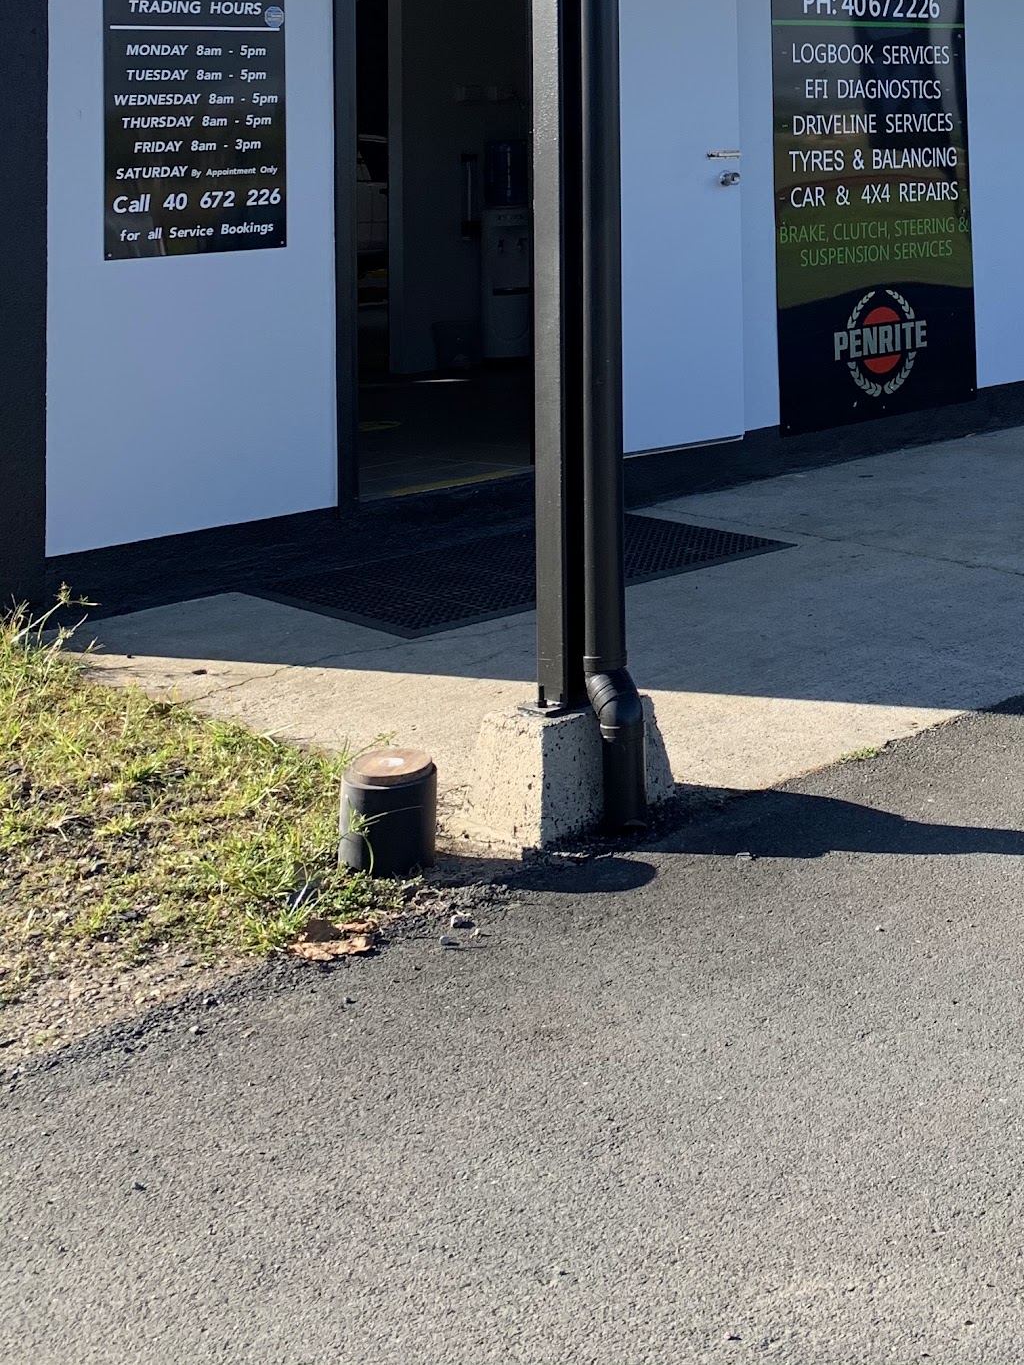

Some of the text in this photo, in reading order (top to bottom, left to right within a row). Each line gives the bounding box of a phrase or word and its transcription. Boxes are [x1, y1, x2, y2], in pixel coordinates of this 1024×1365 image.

[128, 0, 262, 16] TRADING HOURS
[126, 44, 188, 56] MONDAY
[196, 45, 222, 56] 8am
[239, 45, 266, 59] 5pm
[792, 43, 949, 64] LOGBOOK SERVICES
[126, 69, 188, 81] TUESDAY
[196, 69, 222, 81] 8am
[239, 69, 266, 83] 5pm
[805, 79, 941, 99] EFI DIAGNOSTICS
[114, 93, 201, 105] WEDNESDAY
[209, 93, 234, 105] 8am
[252, 93, 278, 107] 5pm
[122, 116, 194, 129] THURSDAY
[202, 115, 227, 127] 8am
[245, 115, 272, 129] 5pm
[793, 113, 953, 135] DRIVELINE SERVICES
[134, 141, 183, 153] FRIDAY
[190, 140, 216, 152] 8am
[235, 139, 261, 152] 3pm
[789, 147, 958, 172] TYRES & BALANCING
[116, 165, 278, 179] SATURDAY By Appointment Only
[113, 188, 281, 214] Call 40 672 226
[790, 182, 958, 208] CAR & 4X4 REPAIRS
[120, 222, 274, 241] for all Service Bookings
[780, 217, 969, 244] BRAKE, CLUTCH, STEERING &
[801, 240, 952, 267] SUSPENSION SERVICES
[834, 320, 927, 361] PENRITE
